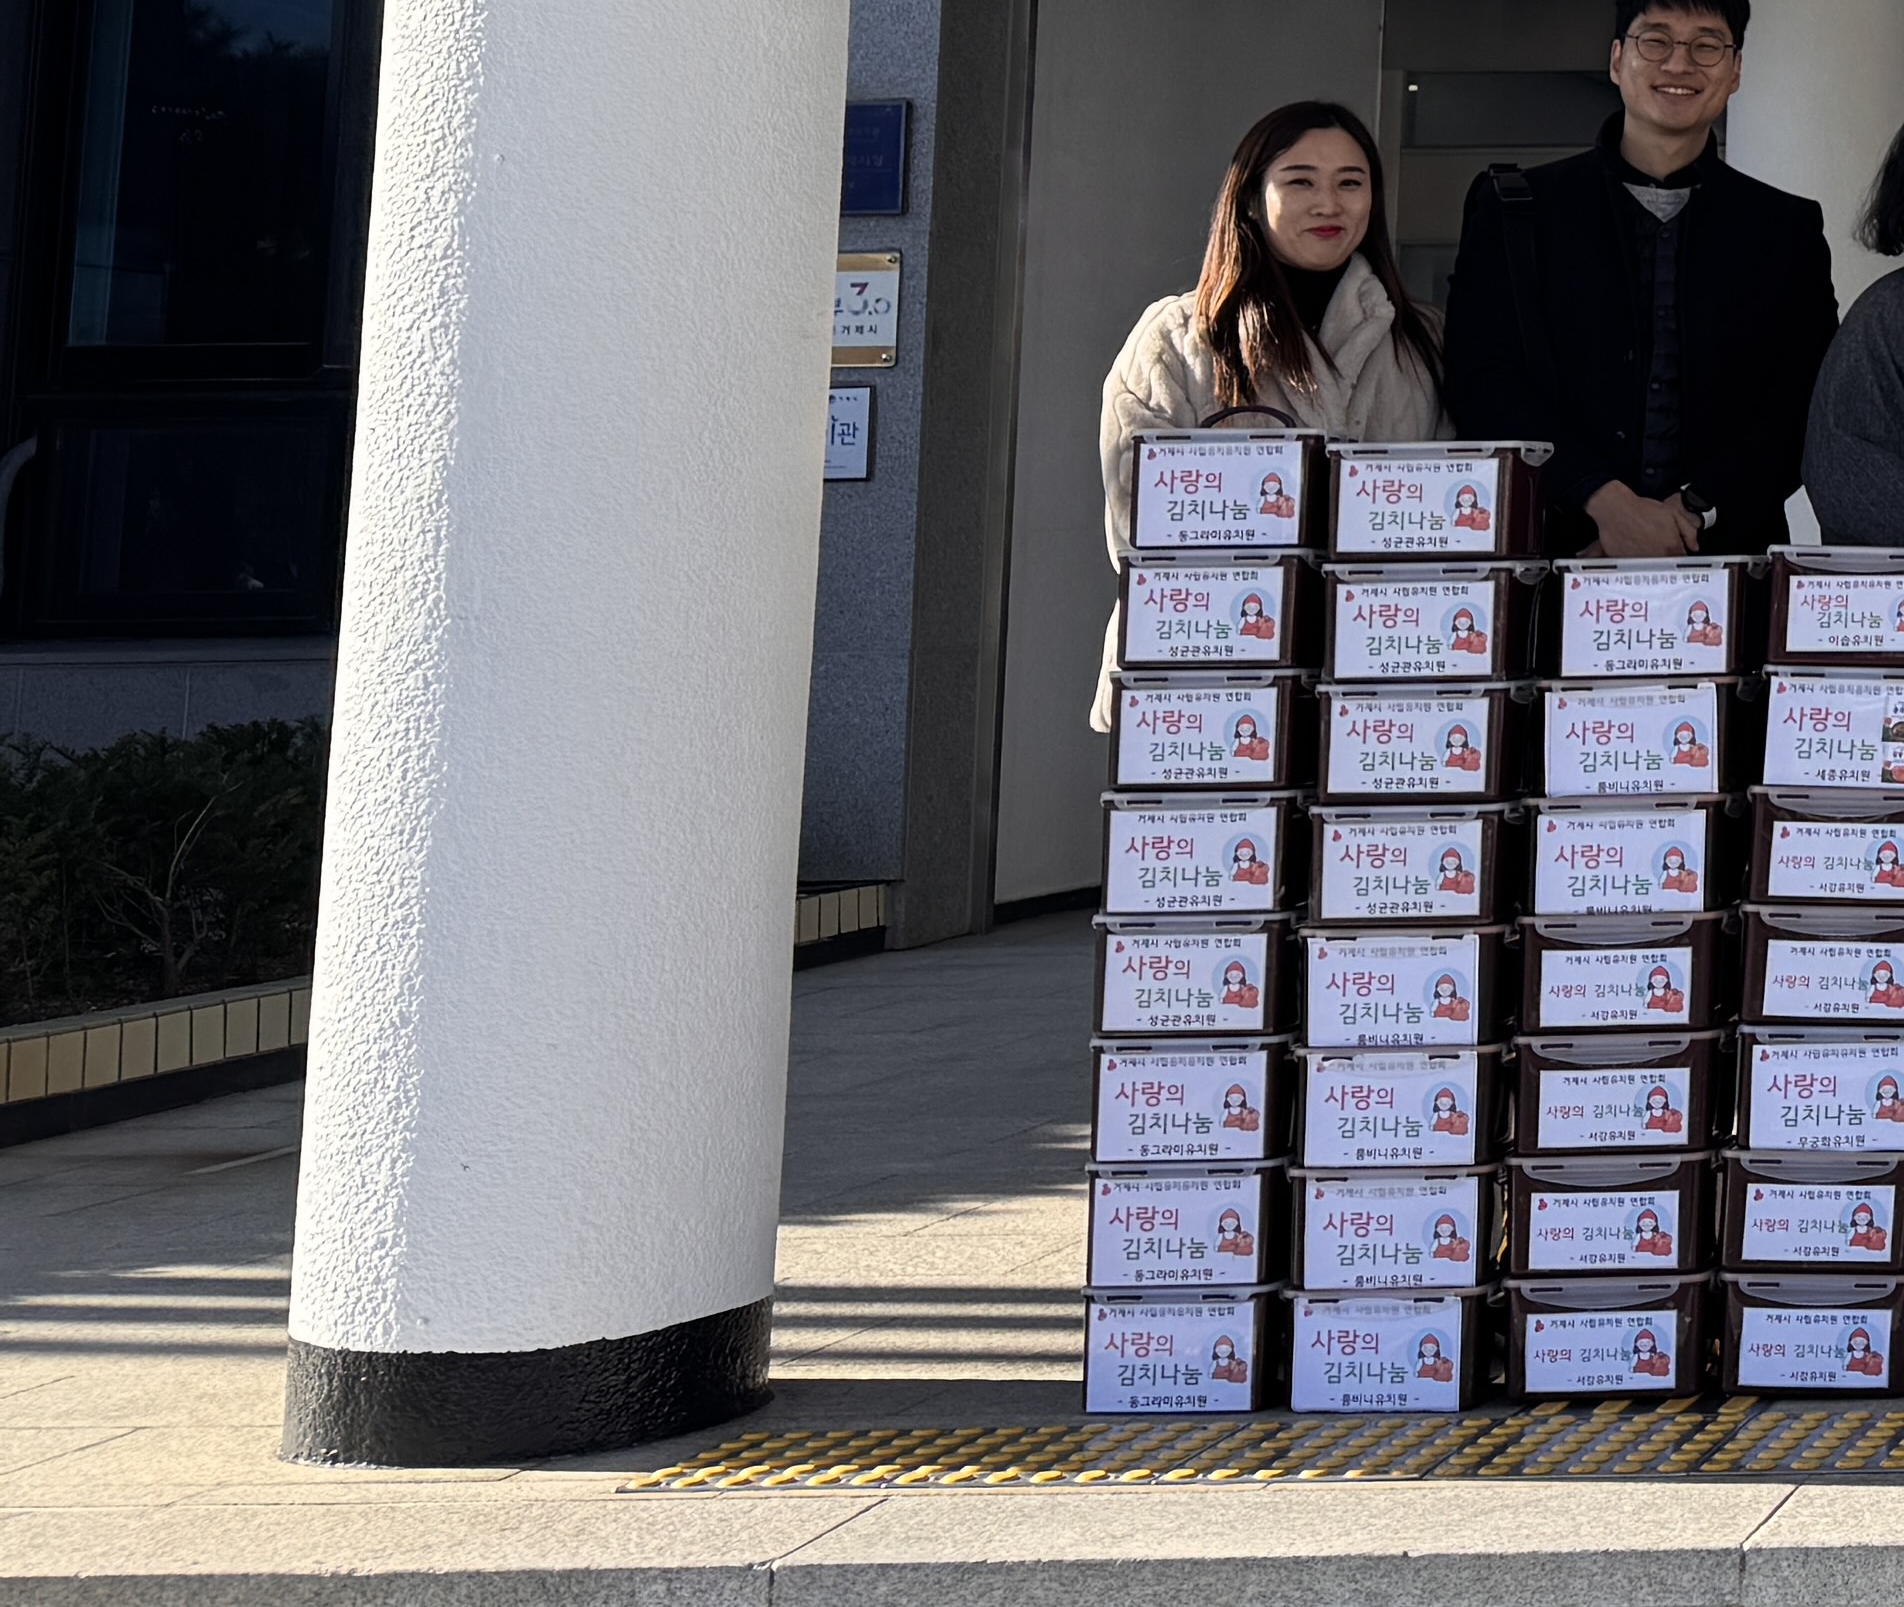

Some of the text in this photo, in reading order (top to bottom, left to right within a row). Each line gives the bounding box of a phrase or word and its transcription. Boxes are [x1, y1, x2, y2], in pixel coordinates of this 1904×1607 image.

[1154, 469, 1222, 495] 사랑의
[1167, 499, 1251, 522] 김치나눔
[1579, 598, 1648, 624] 사랑의
[1800, 594, 1848, 611] 사랑의
[1817, 611, 1883, 629] 김치나눔
[1593, 628, 1678, 651] 김치나눔
[1124, 835, 1194, 861] 사랑의
[1138, 865, 1223, 889] 김치나눔
[1155, 894, 1222, 908] 성균관유치원
[1549, 983, 1646, 998] 사랑의 김치나눔
[1324, 1085, 1394, 1111] 사랑의
[1767, 1073, 1836, 1100] 사랑의
[1337, 1115, 1424, 1139] 김치나눔
[1780, 1104, 1866, 1127] 김치나눔
[1797, 1135, 1865, 1148] 무궁화유치원
[1104, 1331, 1173, 1358] 사랑의
[1311, 1329, 1379, 1356] 사랑의
[1117, 1363, 1203, 1387] 김치나눔
[1323, 1361, 1409, 1384] 김치나눔
